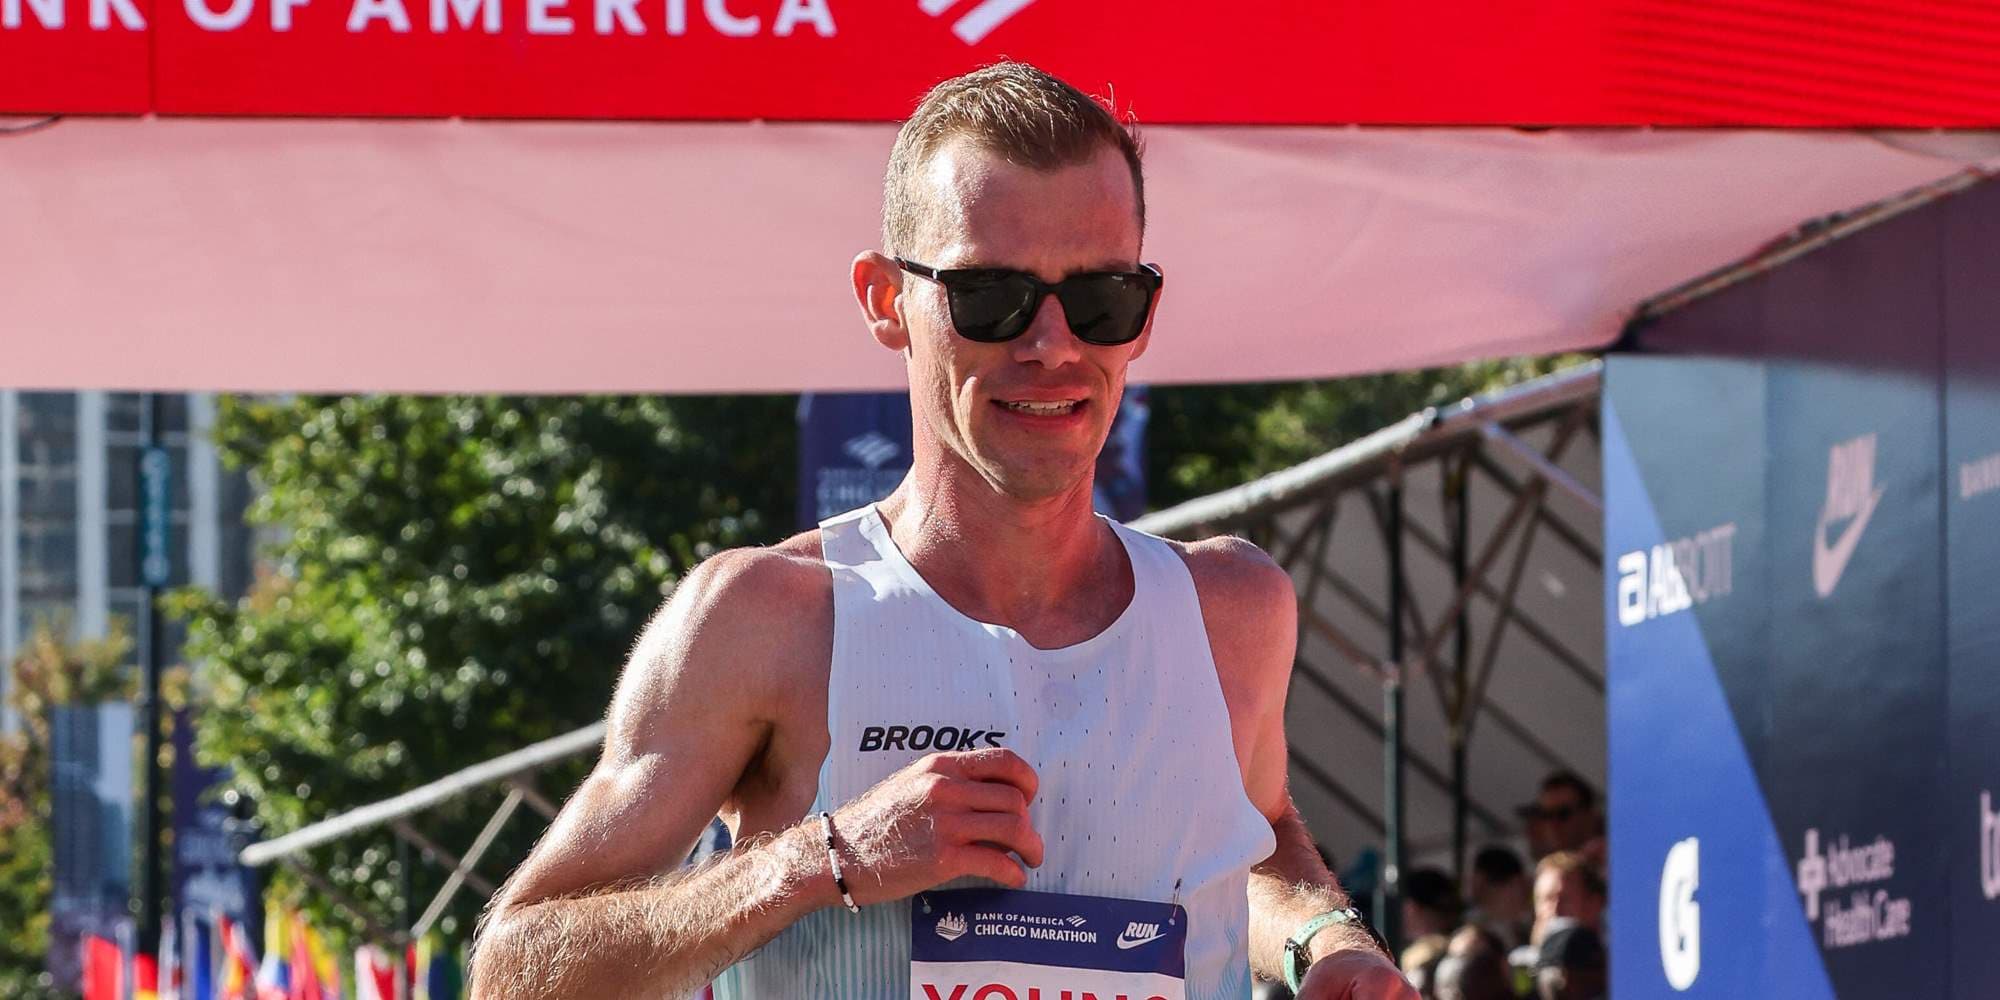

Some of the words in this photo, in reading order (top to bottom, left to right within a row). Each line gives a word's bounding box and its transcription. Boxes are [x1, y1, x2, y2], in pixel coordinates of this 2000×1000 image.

[859, 725, 1006, 752] BROOKS
[975, 913, 1003, 921] BANK
[1005, 913, 1019, 921] OF
[1020, 915, 1065, 926] AMERICA
[975, 924, 1027, 937] CHICAGO
[1030, 927, 1097, 943] MARATHON
[1125, 921, 1160, 939] RUN
